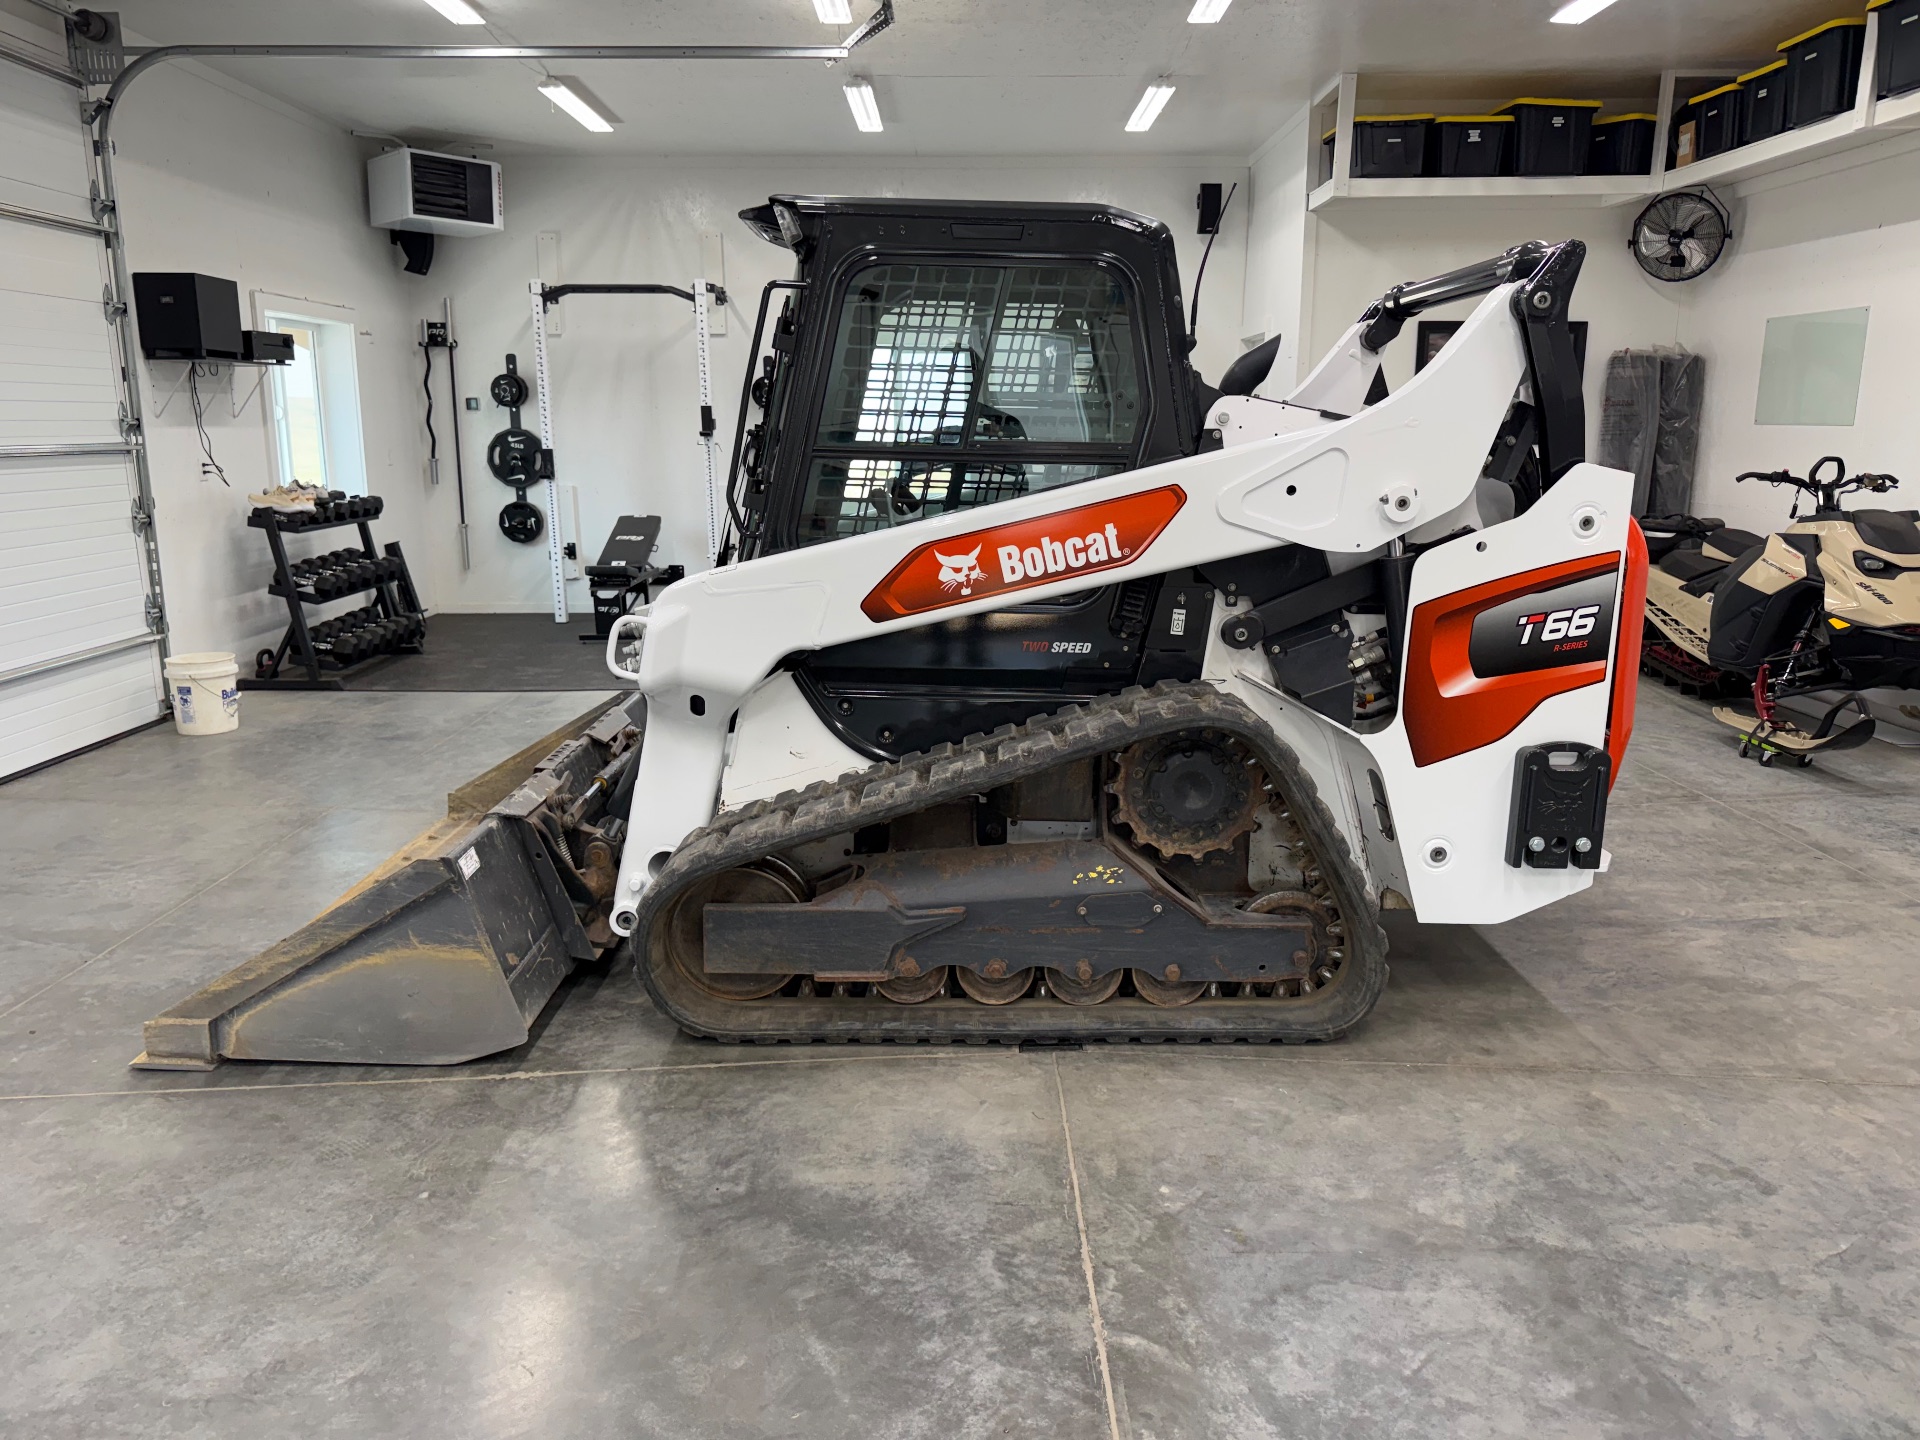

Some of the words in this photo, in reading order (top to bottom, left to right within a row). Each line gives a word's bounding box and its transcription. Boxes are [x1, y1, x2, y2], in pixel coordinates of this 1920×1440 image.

[997, 523, 1122, 584] Bobcat
[1517, 604, 1601, 646] T66
[1022, 640, 1049, 653] TWO
[1051, 641, 1092, 653] SPEED
[1553, 640, 1589, 652] R-SERIES
